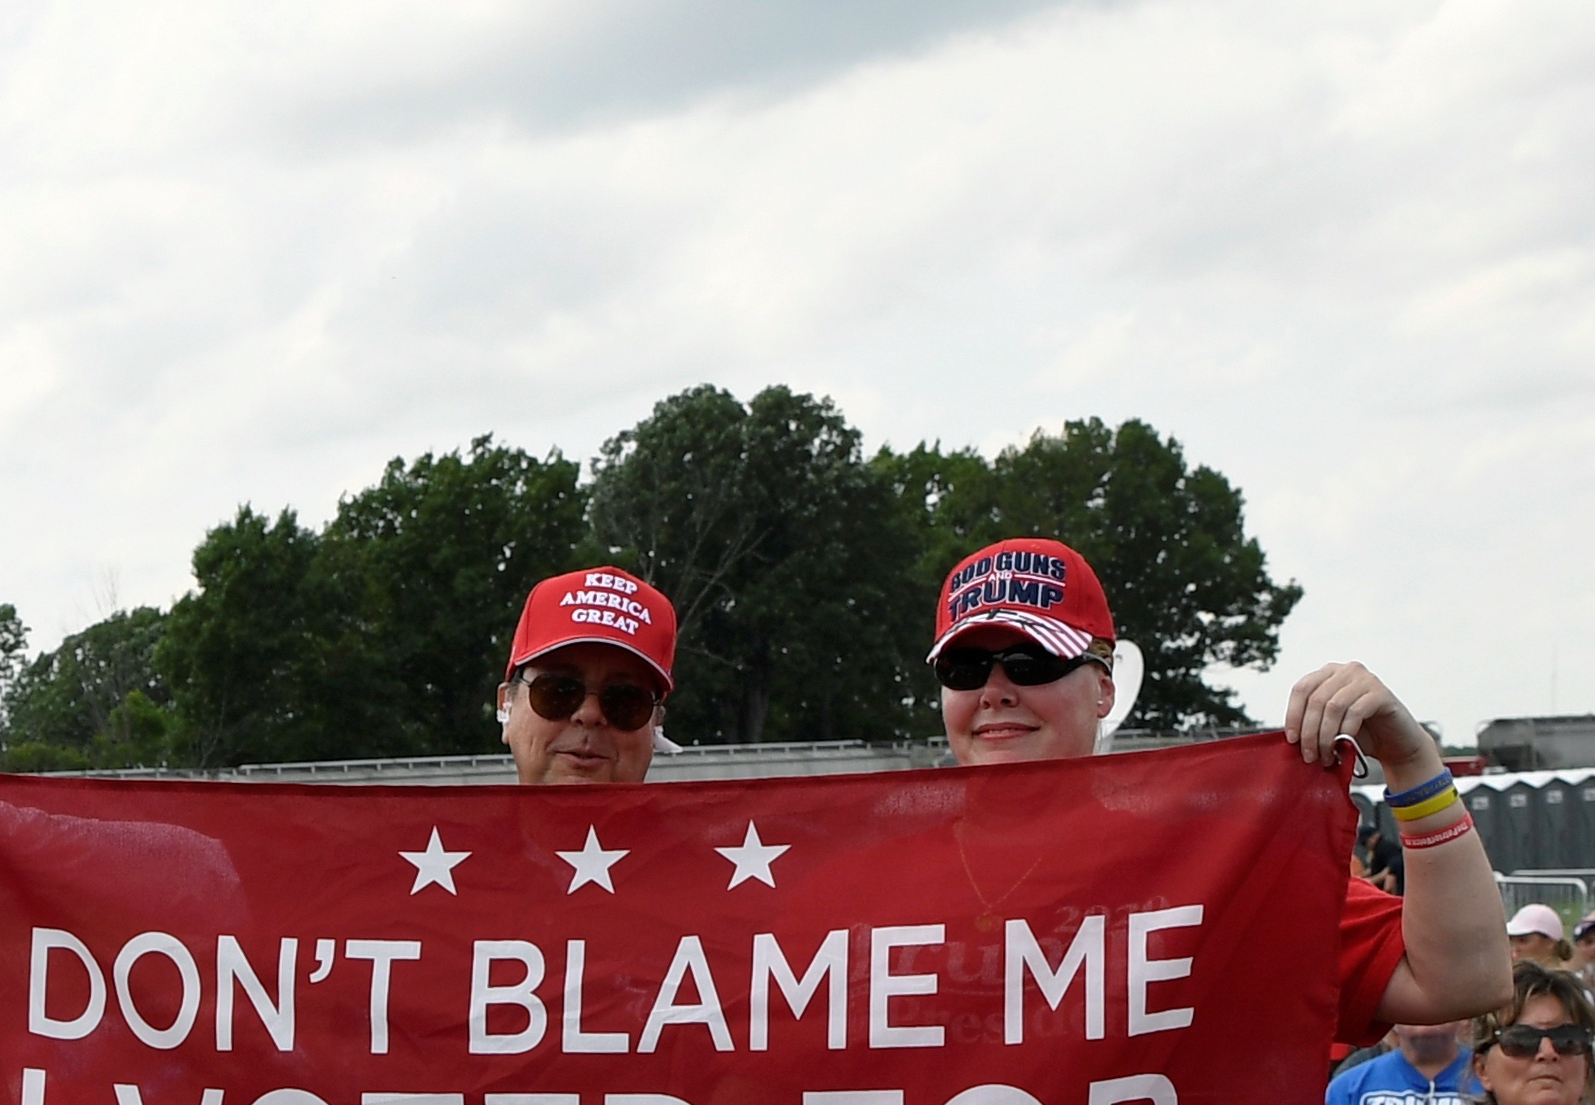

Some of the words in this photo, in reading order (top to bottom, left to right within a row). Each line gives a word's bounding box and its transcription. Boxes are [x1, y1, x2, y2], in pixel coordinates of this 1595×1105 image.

[585, 573, 637, 595] KEEP
[951, 556, 992, 595] GOD
[995, 551, 1066, 582] GUNS
[988, 572, 1012, 582] AND
[560, 591, 652, 625] AMERICA
[948, 579, 1065, 624] TRUMP
[572, 608, 639, 635] GREAT
[469, 923, 946, 1055] BLAME
[1005, 904, 1204, 1046] ME
